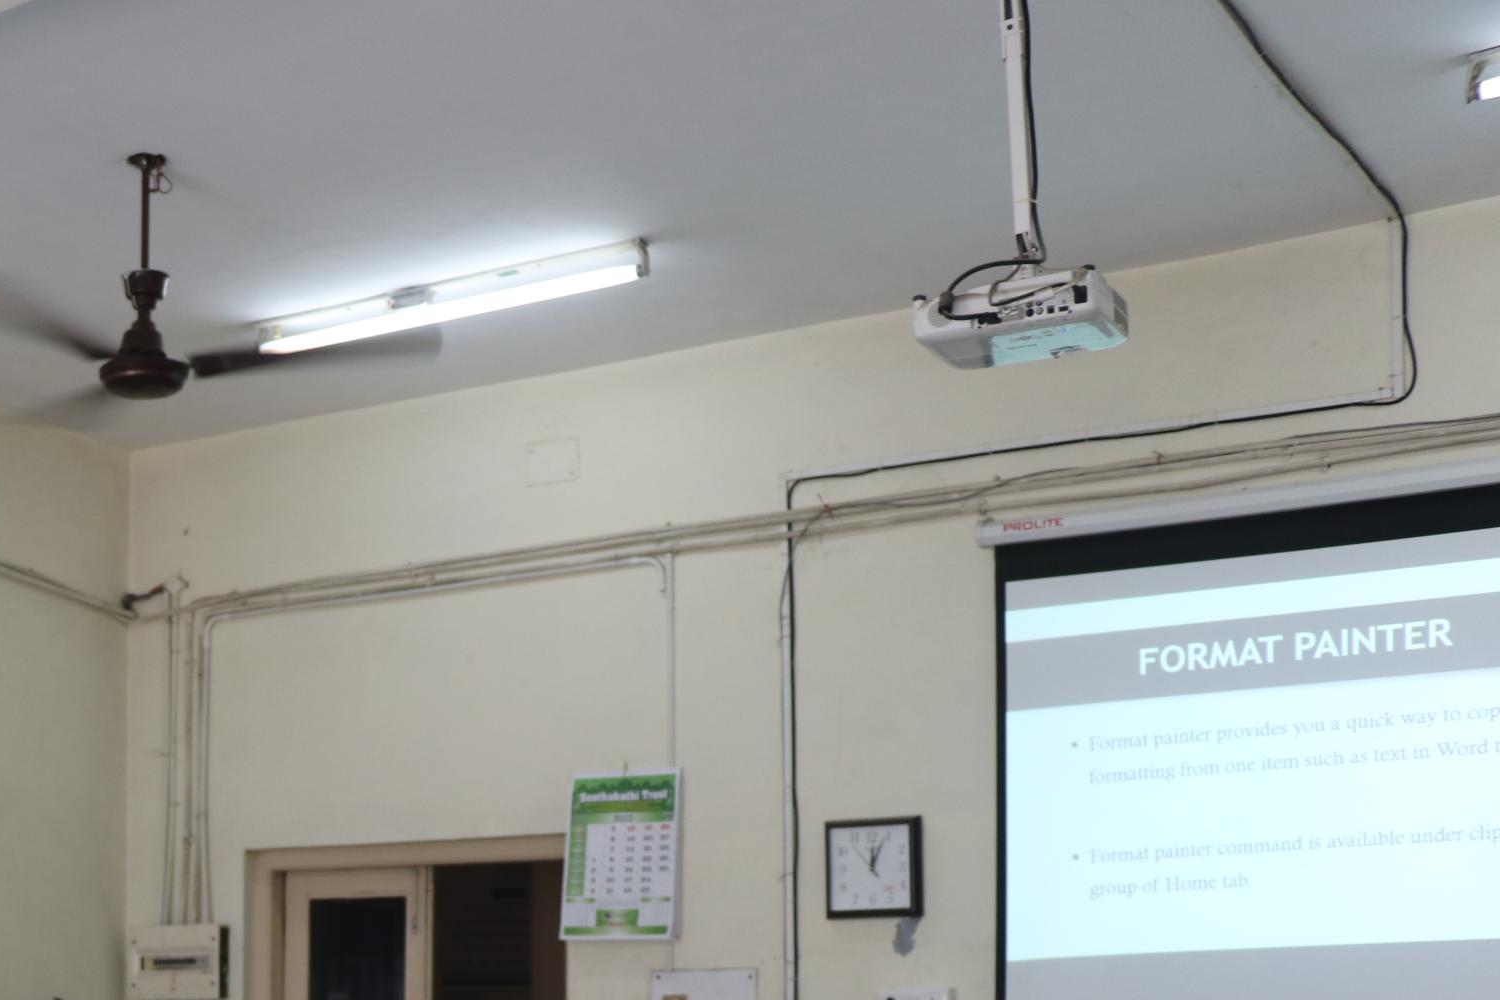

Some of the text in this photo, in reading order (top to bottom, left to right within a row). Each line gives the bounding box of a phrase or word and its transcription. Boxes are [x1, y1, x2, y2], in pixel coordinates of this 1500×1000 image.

[1003, 516, 1064, 533] PROLITE
[1138, 617, 1455, 676] FORMAT PAINTER
[1088, 733, 1149, 752] Format
[1153, 728, 1213, 750] painter
[1216, 721, 1289, 746] provides
[1293, 718, 1326, 738] you
[1330, 719, 1341, 731] a
[1345, 711, 1396, 734] quick
[1400, 711, 1438, 728] way
[1442, 708, 1462, 723] to
[1088, 765, 1176, 785] formatting
[1179, 759, 1220, 778] from
[1224, 757, 1257, 773] one
[1260, 754, 1299, 772] item
[1304, 750, 1344, 768] such
[1349, 751, 1369, 765] as
[1373, 746, 1408, 763] text
[1412, 744, 1431, 760] in
[1436, 739, 1489, 758] Word
[1089, 847, 1150, 864] Format
[1153, 842, 1213, 864] painter
[1216, 836, 1303, 856] command
[1308, 834, 1322, 850] is
[1326, 829, 1405, 849] available
[1409, 826, 1465, 844] under
[1088, 872, 1252, 901] group of Home tab.
